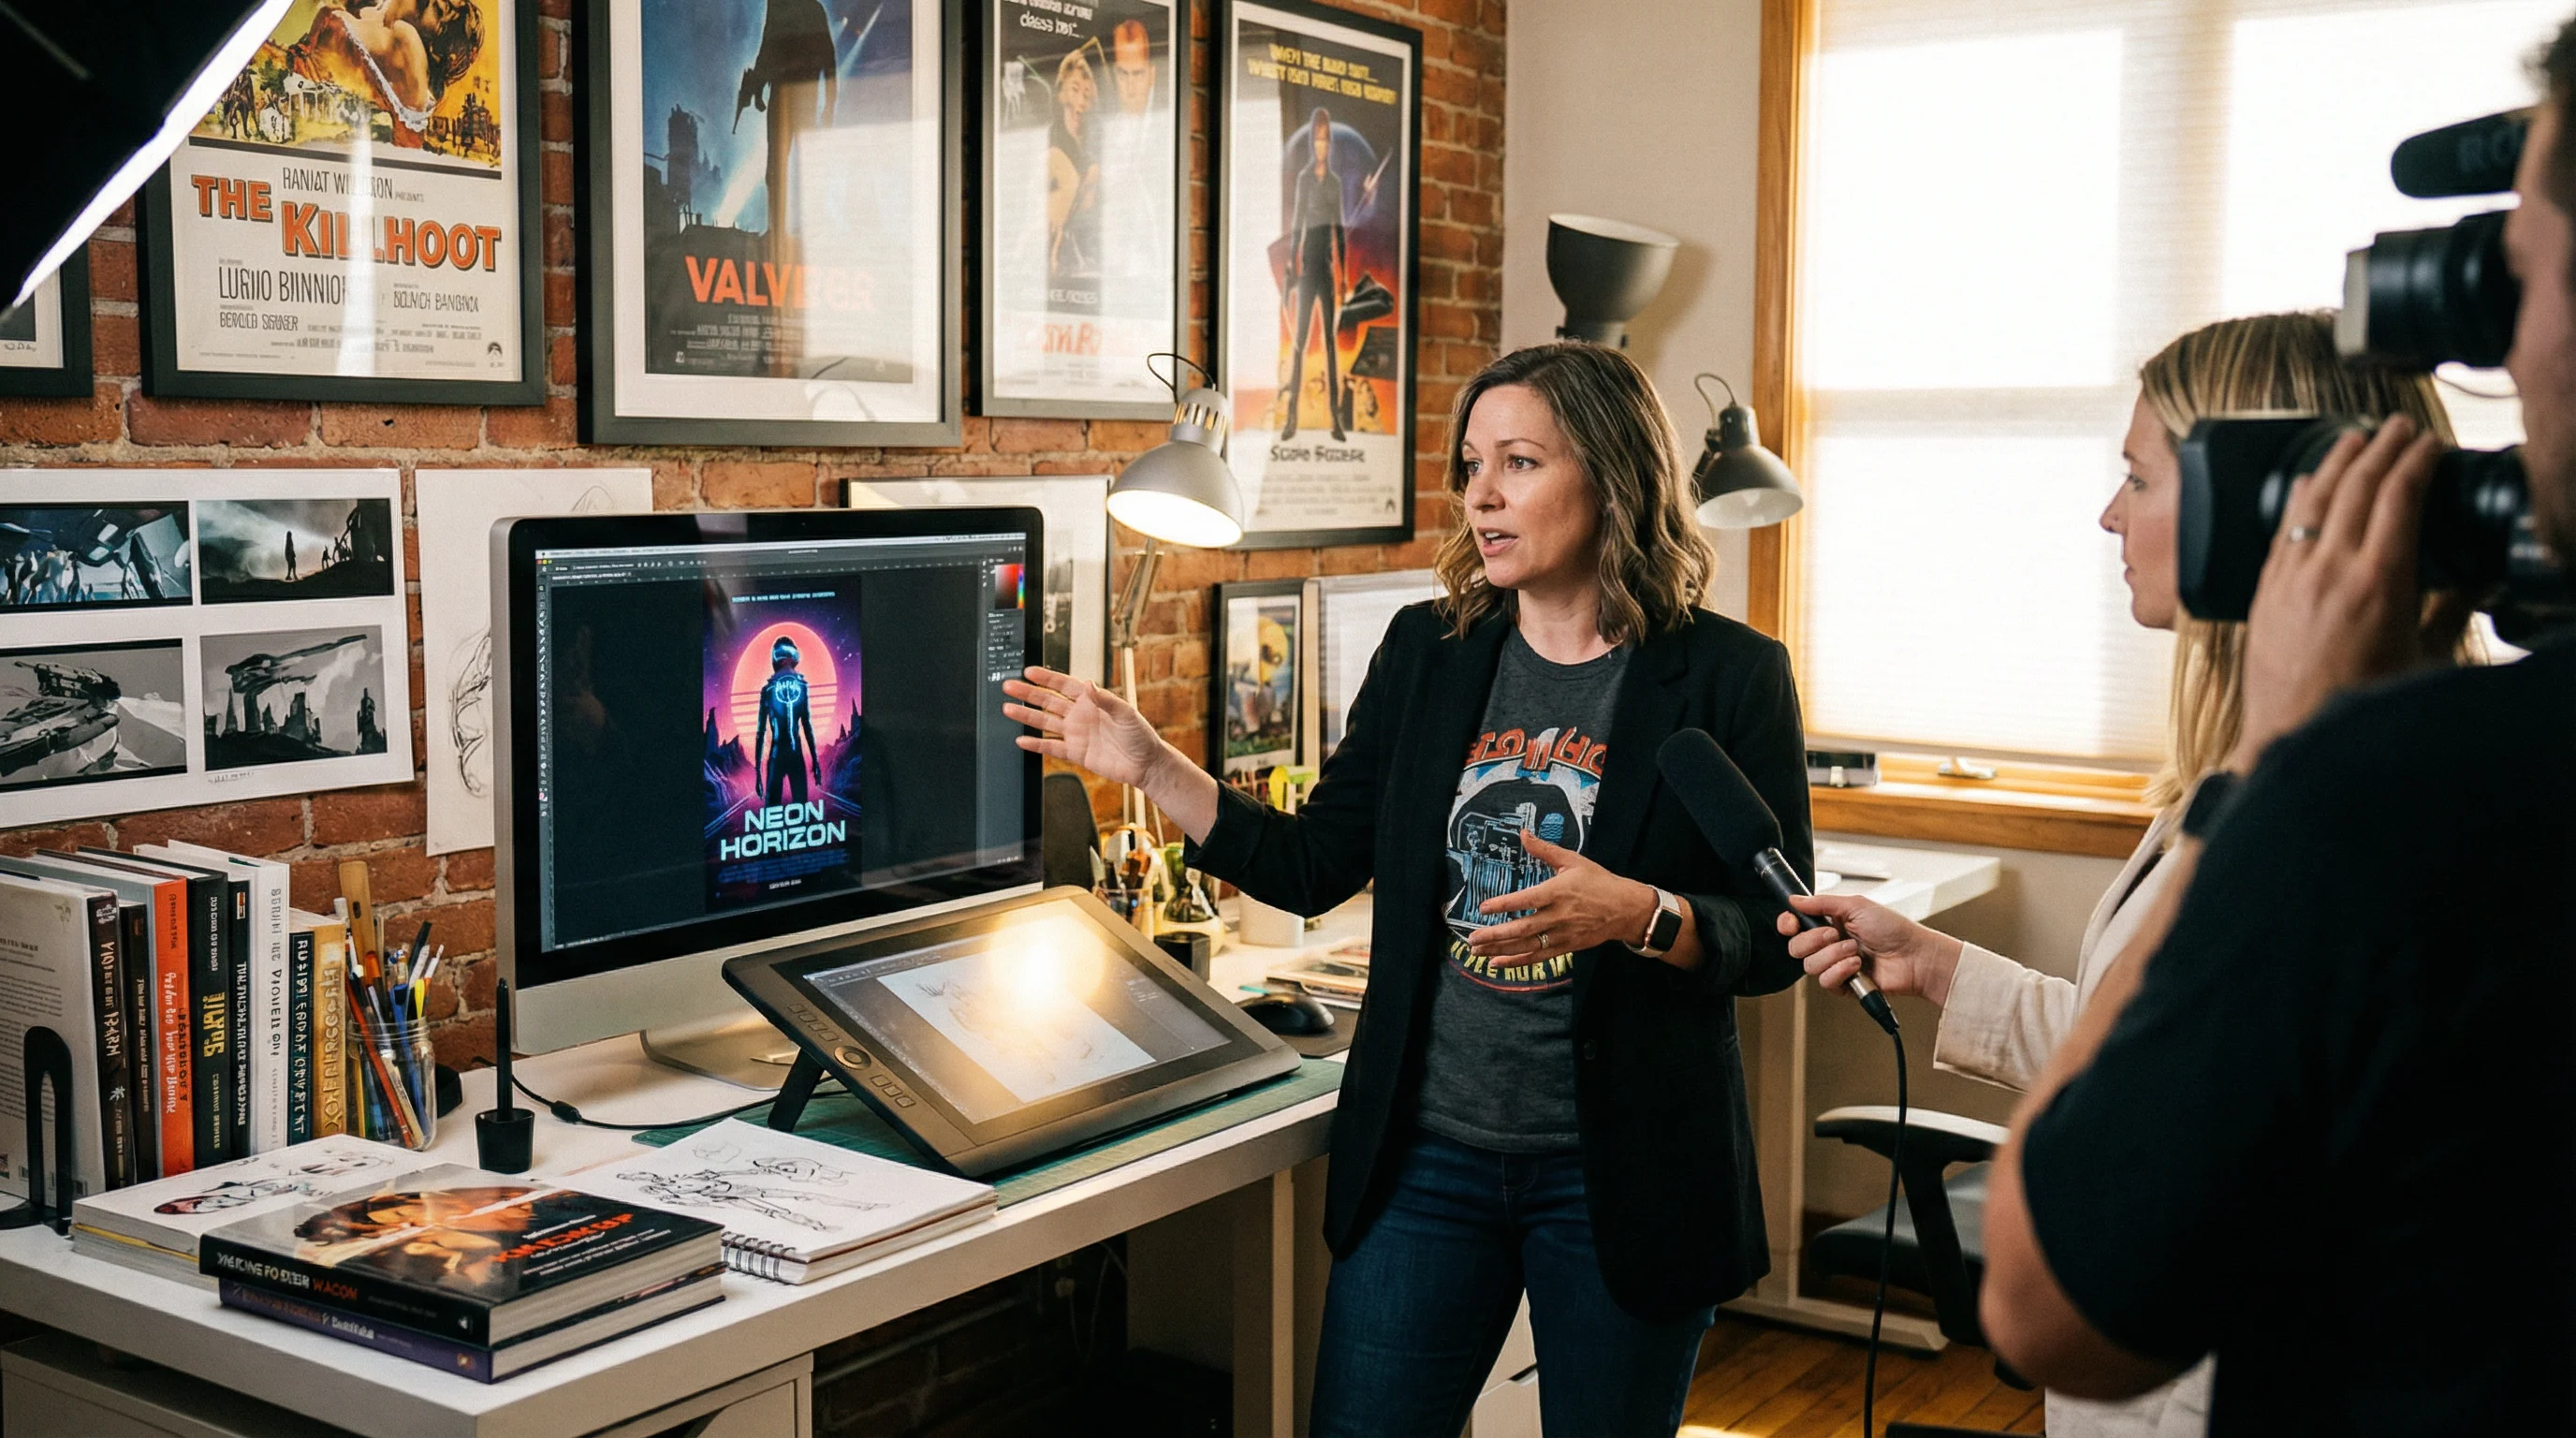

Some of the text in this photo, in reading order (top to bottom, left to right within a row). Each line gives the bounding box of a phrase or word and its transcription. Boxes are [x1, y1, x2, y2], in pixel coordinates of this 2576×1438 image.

[191, 174, 273, 223] THE
[744, 800, 824, 832] NEON
[721, 820, 846, 861] HORIZON
